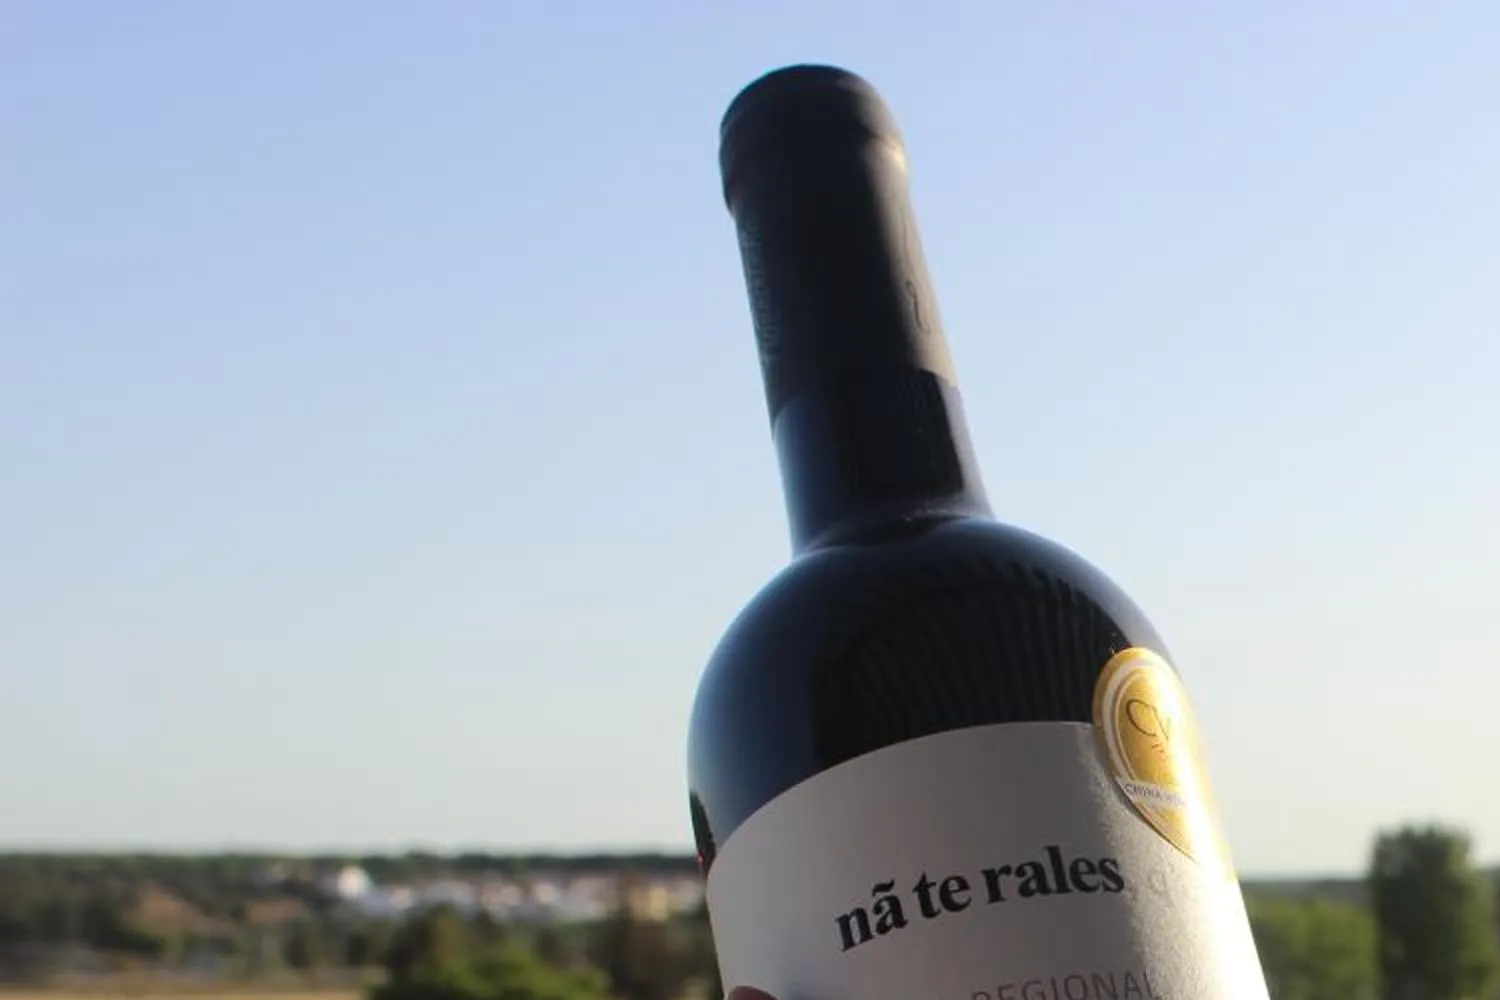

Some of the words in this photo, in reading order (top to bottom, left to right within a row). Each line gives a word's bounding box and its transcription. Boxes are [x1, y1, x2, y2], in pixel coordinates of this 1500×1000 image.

[835, 879, 908, 952] nã
[913, 873, 972, 919] te
[981, 845, 1125, 904] rales
